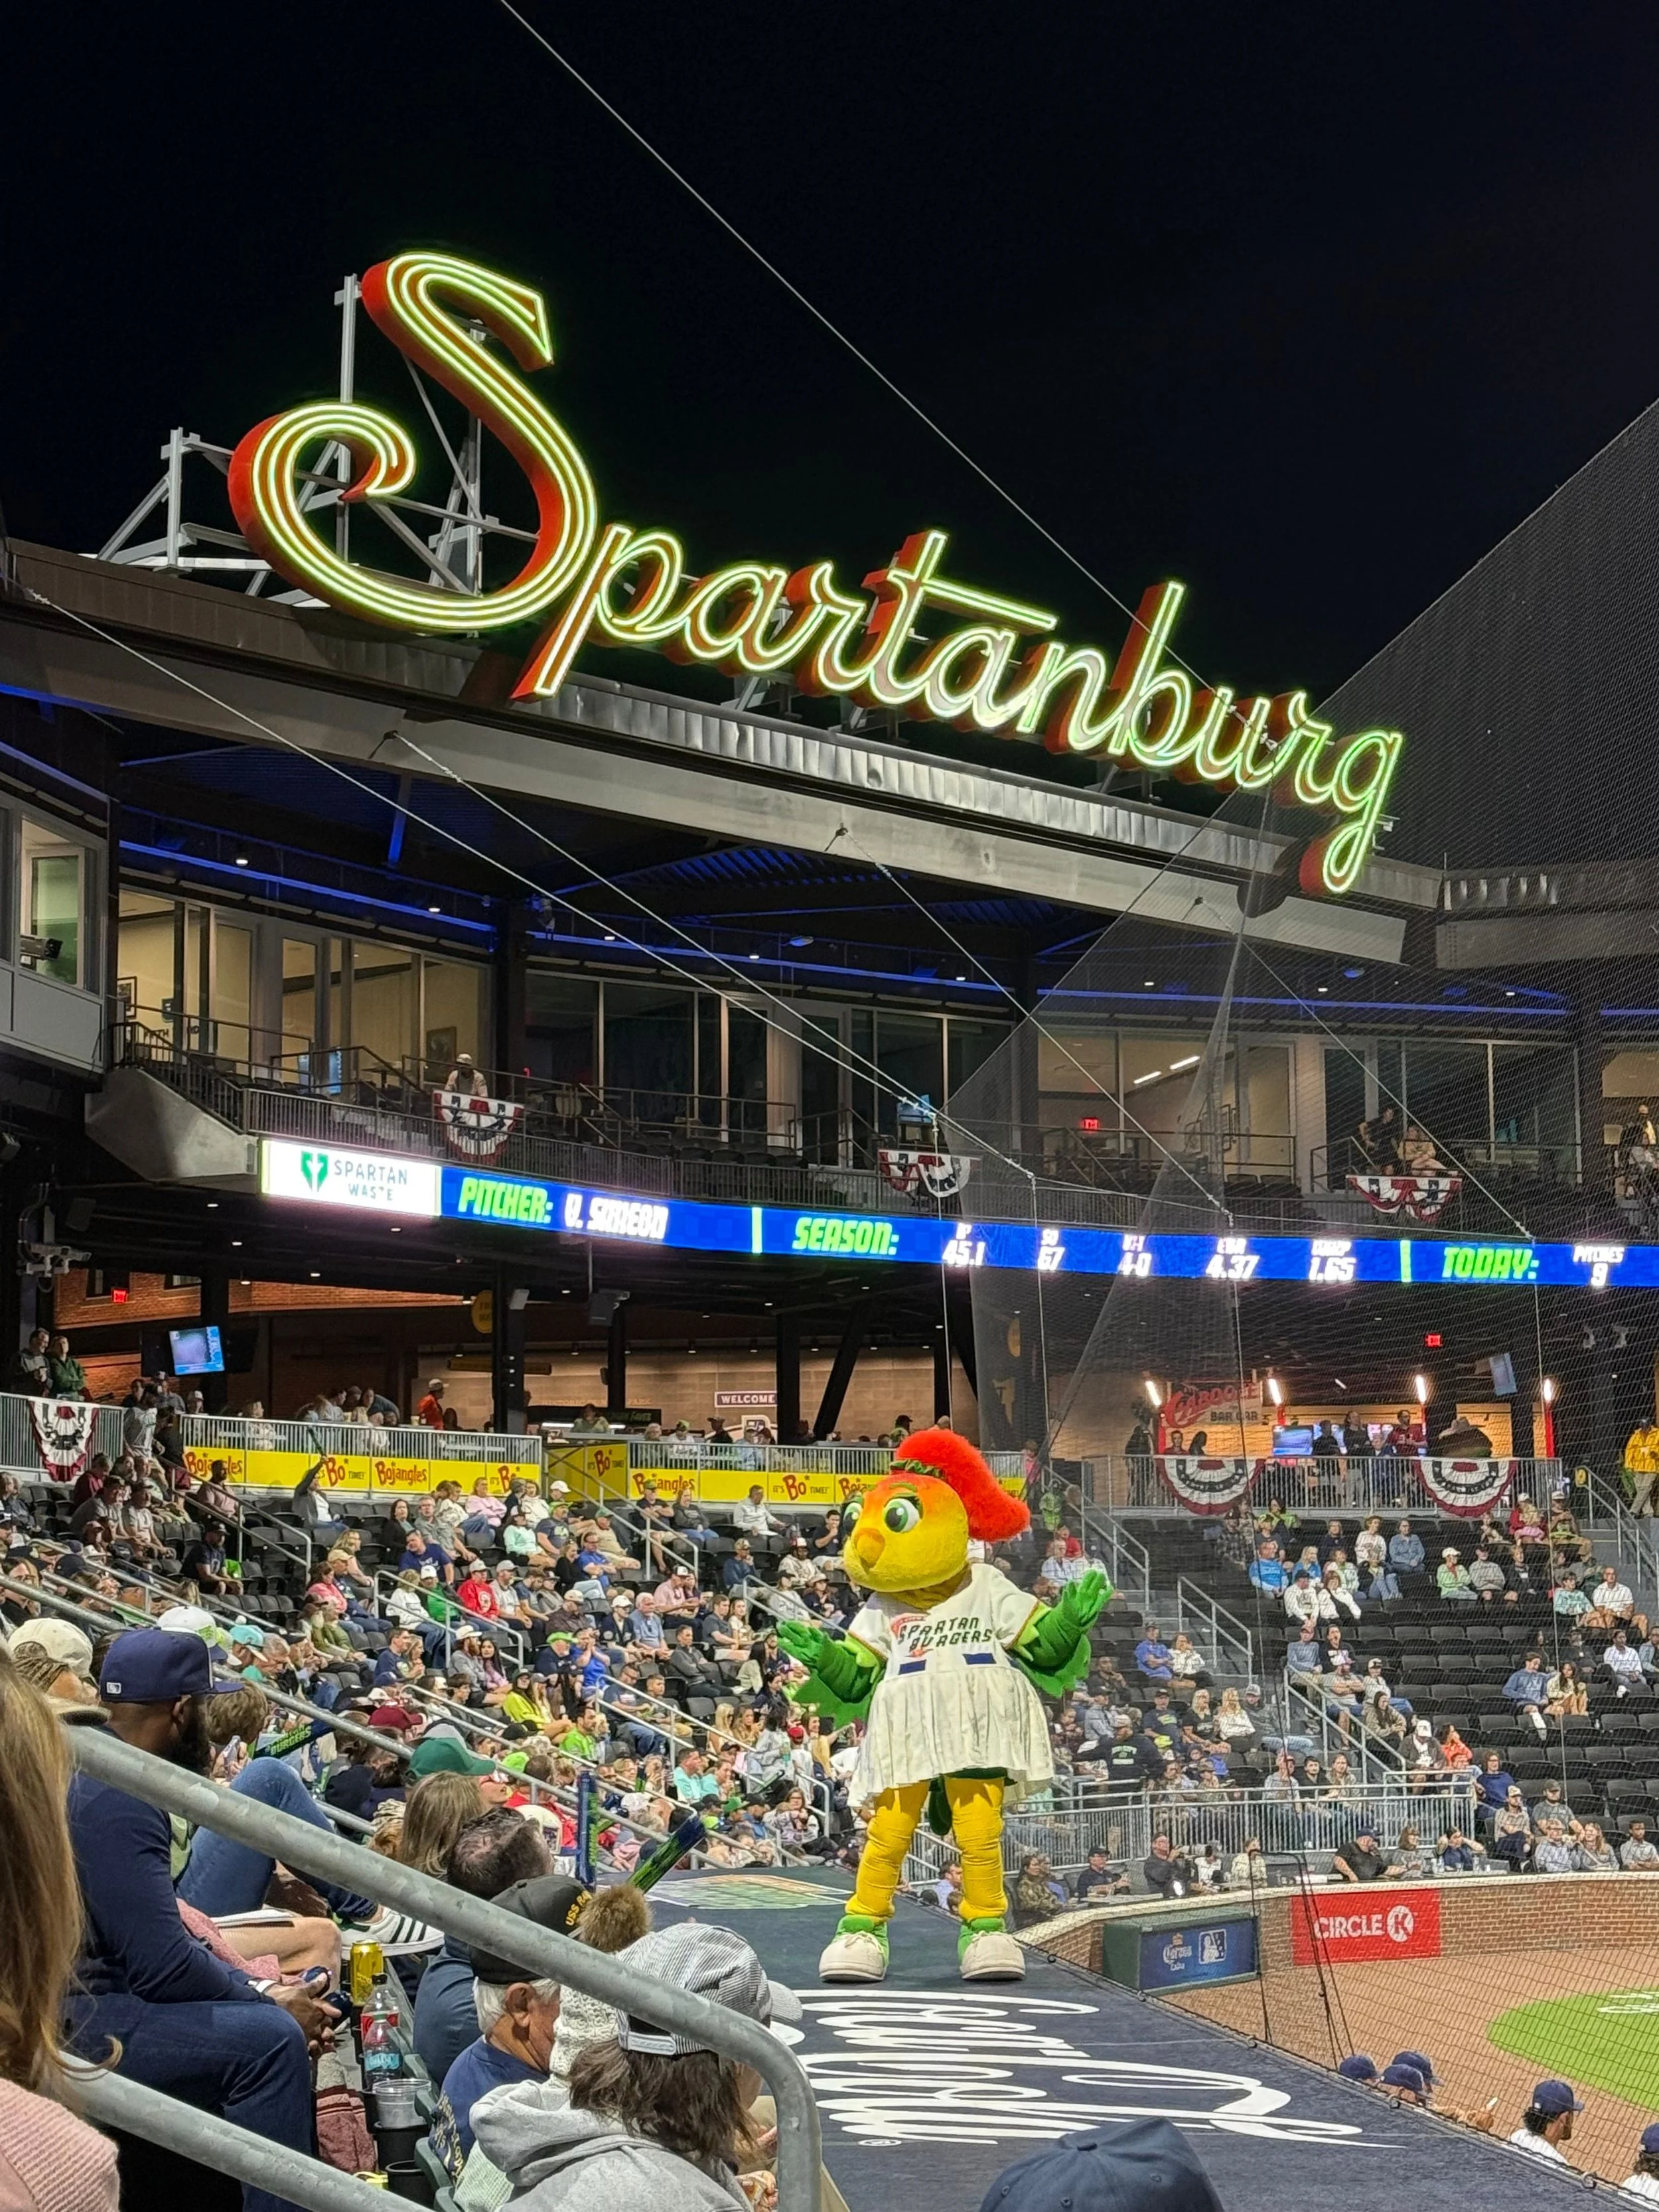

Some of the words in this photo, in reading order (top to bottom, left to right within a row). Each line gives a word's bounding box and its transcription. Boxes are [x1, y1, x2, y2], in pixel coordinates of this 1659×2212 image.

[228, 252, 1404, 896] Spartanburg
[334, 1159, 407, 1185] SPARTAN
[348, 1183, 393, 1201] WASTE
[458, 1177, 553, 1224] PITCHER:
[792, 1217, 899, 1256] SEASON:
[942, 1240, 985, 1266] 45.1
[1442, 1246, 1540, 1280] TODAY:
[1205, 1255, 1260, 1280] 4.37
[1308, 1256, 1356, 1282] 1.65
[1591, 1262, 1608, 1286] 9
[721, 1394, 775, 1404] WELCOME
[184, 1451, 243, 1478] Bojales
[325, 1457, 346, 1487] Bo
[375, 1460, 427, 1487] Bojangles
[594, 1449, 611, 1477] Bo
[632, 1472, 695, 1496] Bangles
[782, 1474, 806, 1501] Bo
[898, 1617, 979, 1645] SPARTAN
[565, 1903, 580, 1926] USS
[1313, 1915, 1386, 1939] CIRCLE
